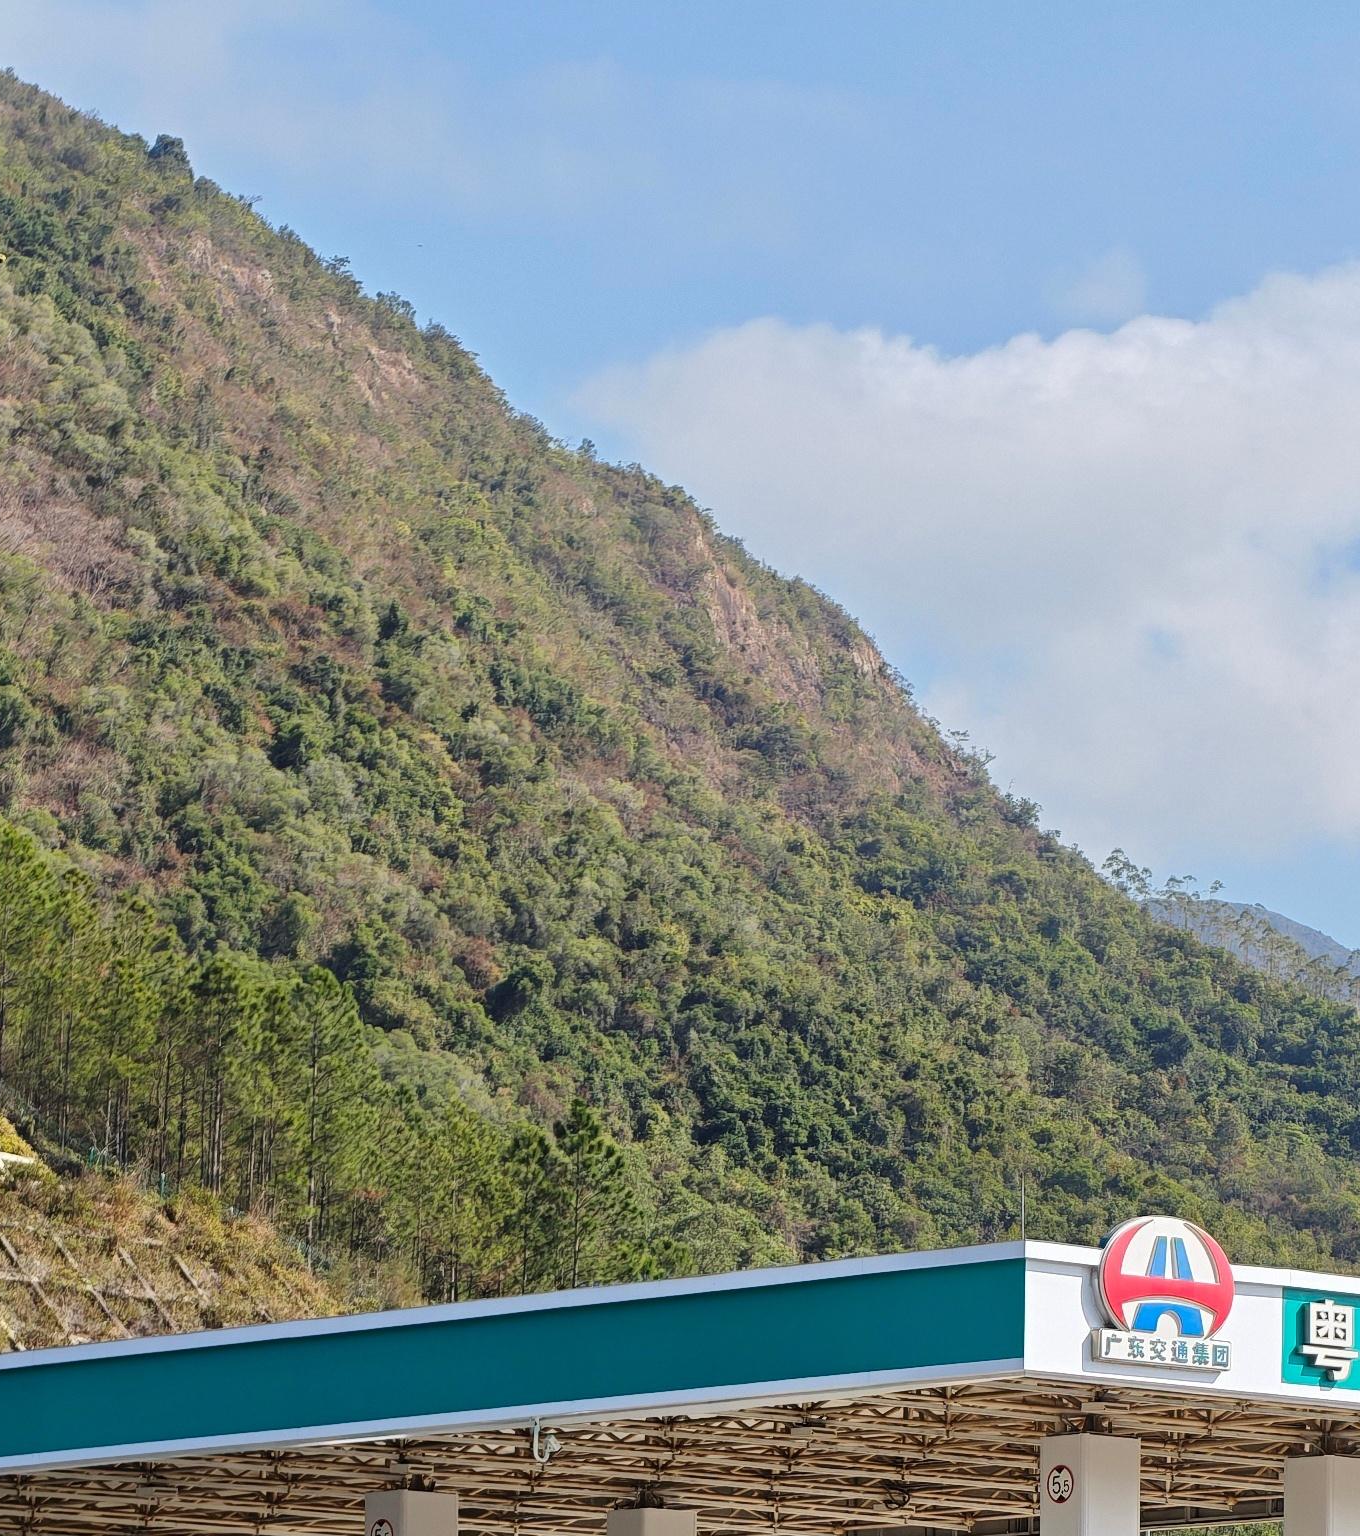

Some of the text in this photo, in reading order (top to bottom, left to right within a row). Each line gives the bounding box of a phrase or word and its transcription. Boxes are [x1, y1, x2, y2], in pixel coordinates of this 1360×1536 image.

[1104, 1331, 1231, 1371] 广东交通集团
